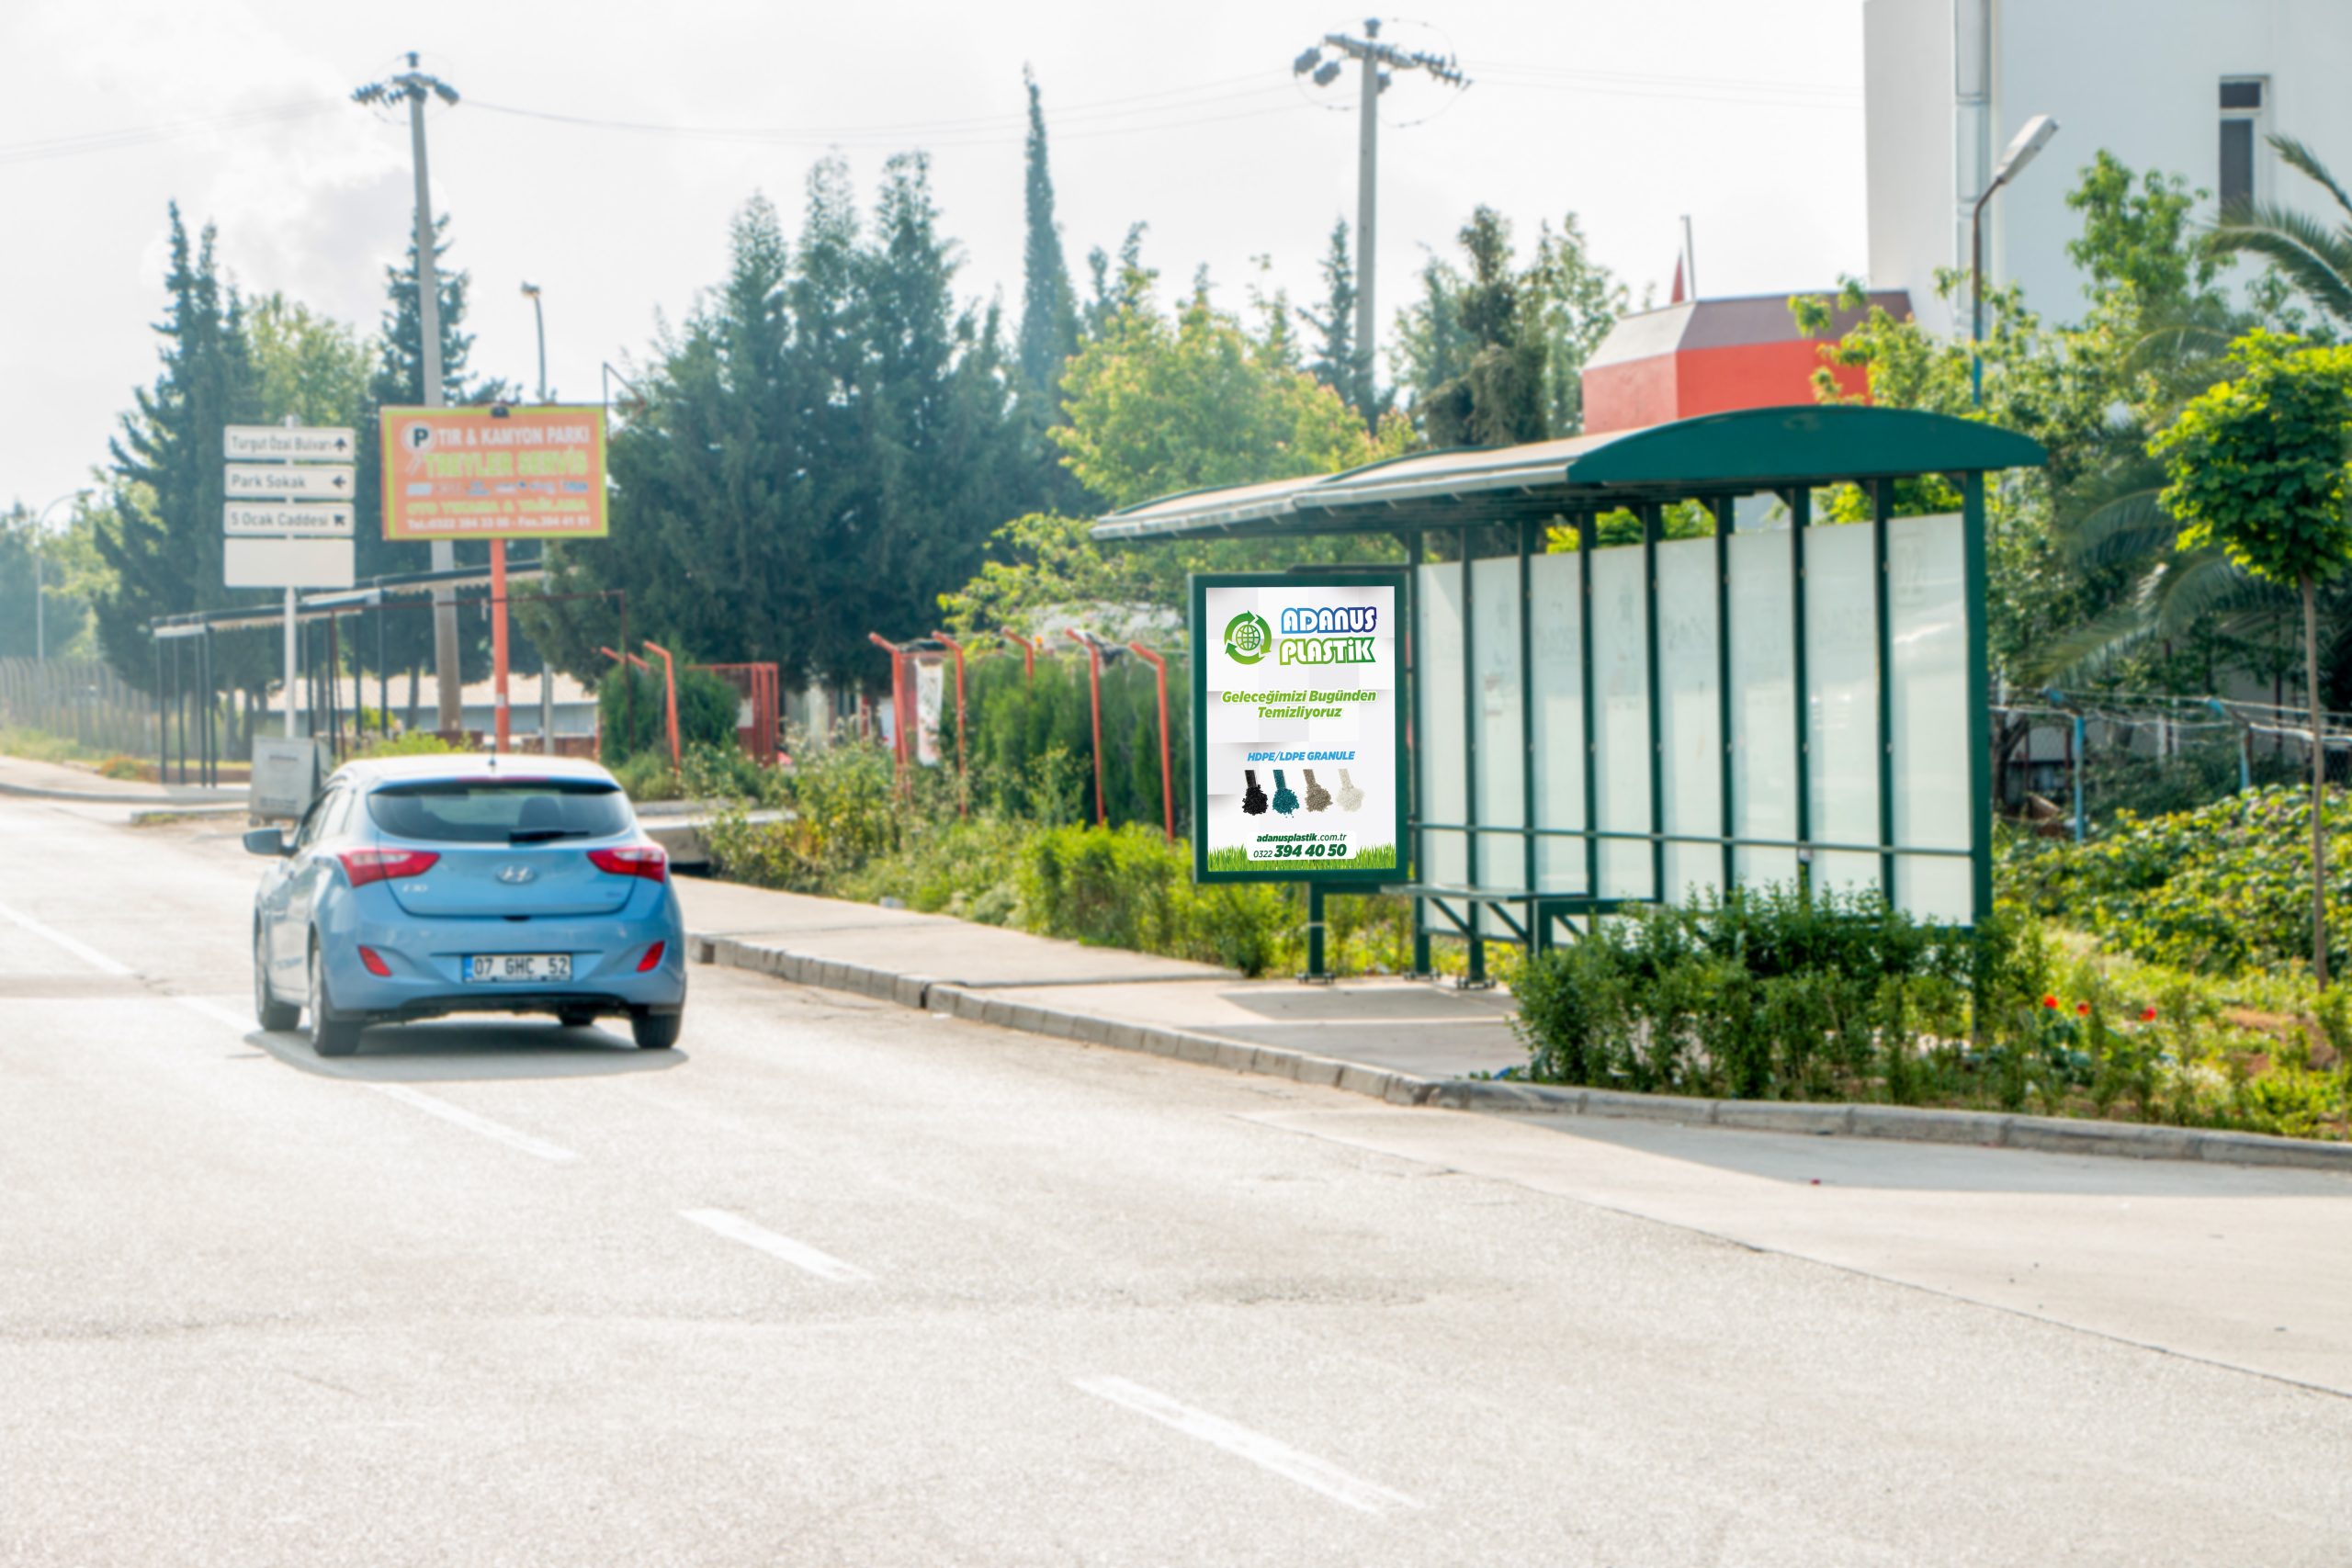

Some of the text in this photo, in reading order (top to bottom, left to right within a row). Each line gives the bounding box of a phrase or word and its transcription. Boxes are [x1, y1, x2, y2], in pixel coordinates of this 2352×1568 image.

[232, 435, 266, 453] Turgut
[270, 434, 291, 450] Özal
[414, 427, 428, 447] P
[481, 427, 543, 446] KAMYON
[424, 451, 514, 478] TREYLER
[232, 474, 306, 489] Park Sokak
[232, 513, 328, 526] 5 Ocak Caddesi
[1281, 606, 1377, 634] ADANUS
[1222, 689, 1376, 704] Geleceğimizi Bugünden
[1258, 706, 1342, 719] Temizliyoruz
[1248, 750, 1355, 761] HDPE/LDPE GRANULE
[1257, 832, 1347, 843] adanusplastik.com.tr
[1274, 844, 1302, 857] 394
[1305, 844, 1326, 857] 40
[1328, 843, 1347, 857] 50
[474, 956, 568, 975] 07 GHC 52
